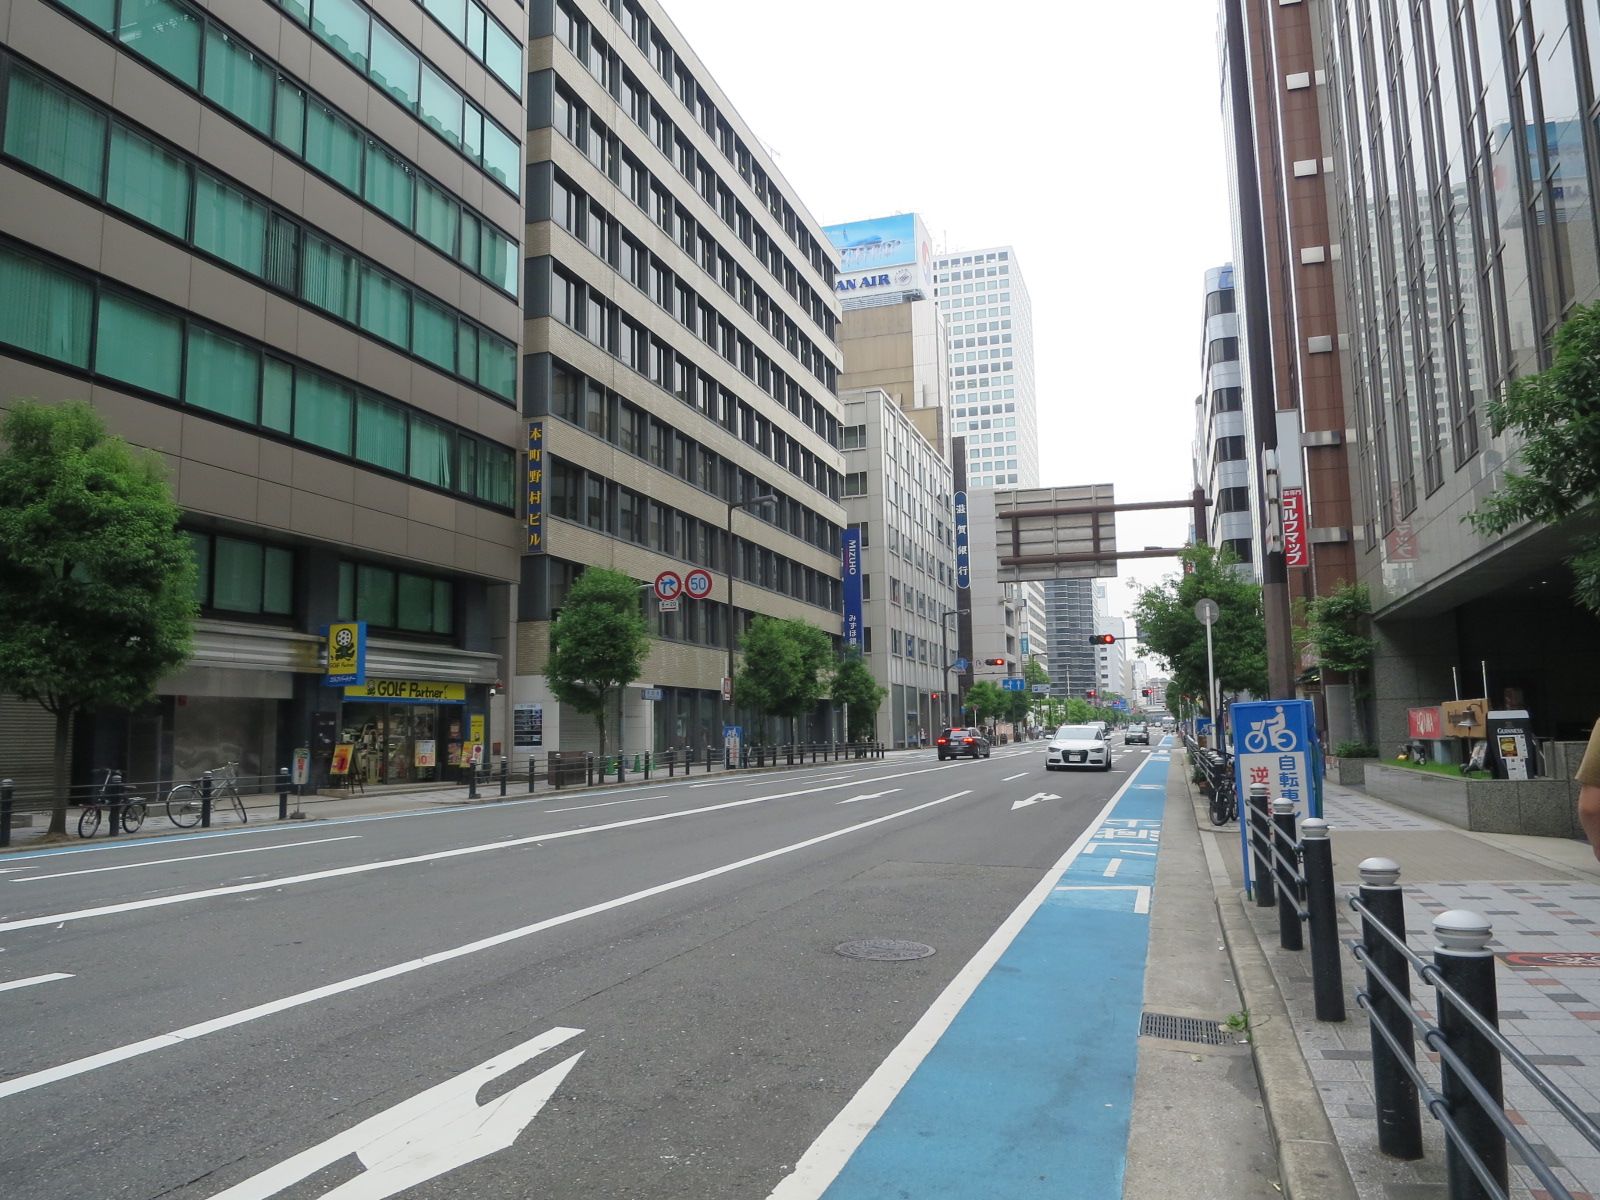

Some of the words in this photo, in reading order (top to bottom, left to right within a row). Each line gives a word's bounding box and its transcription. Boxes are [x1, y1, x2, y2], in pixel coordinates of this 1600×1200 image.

[860, 274, 891, 288] AIR
[529, 427, 542, 546] 本町野村ビル
[955, 503, 968, 576] 滋賀銀行
[848, 540, 857, 575] MIZUHO
[690, 577, 707, 591] 50
[377, 681, 407, 697] GOLF
[1497, 727, 1524, 735] GUINNESS
